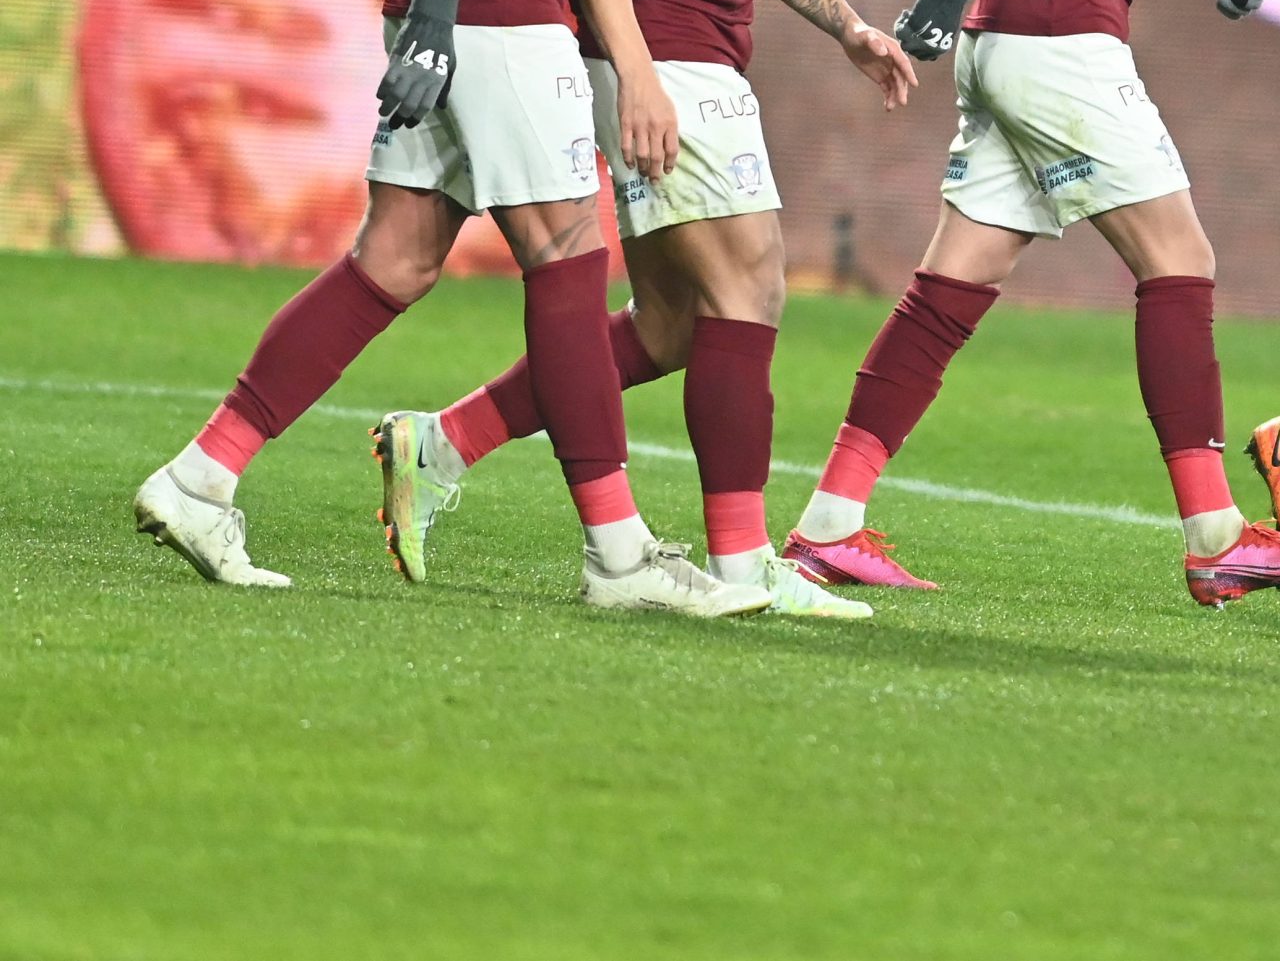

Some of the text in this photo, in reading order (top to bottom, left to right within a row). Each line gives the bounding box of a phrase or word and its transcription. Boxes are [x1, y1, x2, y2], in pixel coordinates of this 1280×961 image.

[924, 27, 954, 50] 26
[413, 48, 449, 76] 45
[699, 93, 757, 123] PLUS
[1049, 166, 1094, 189] BANEASA
